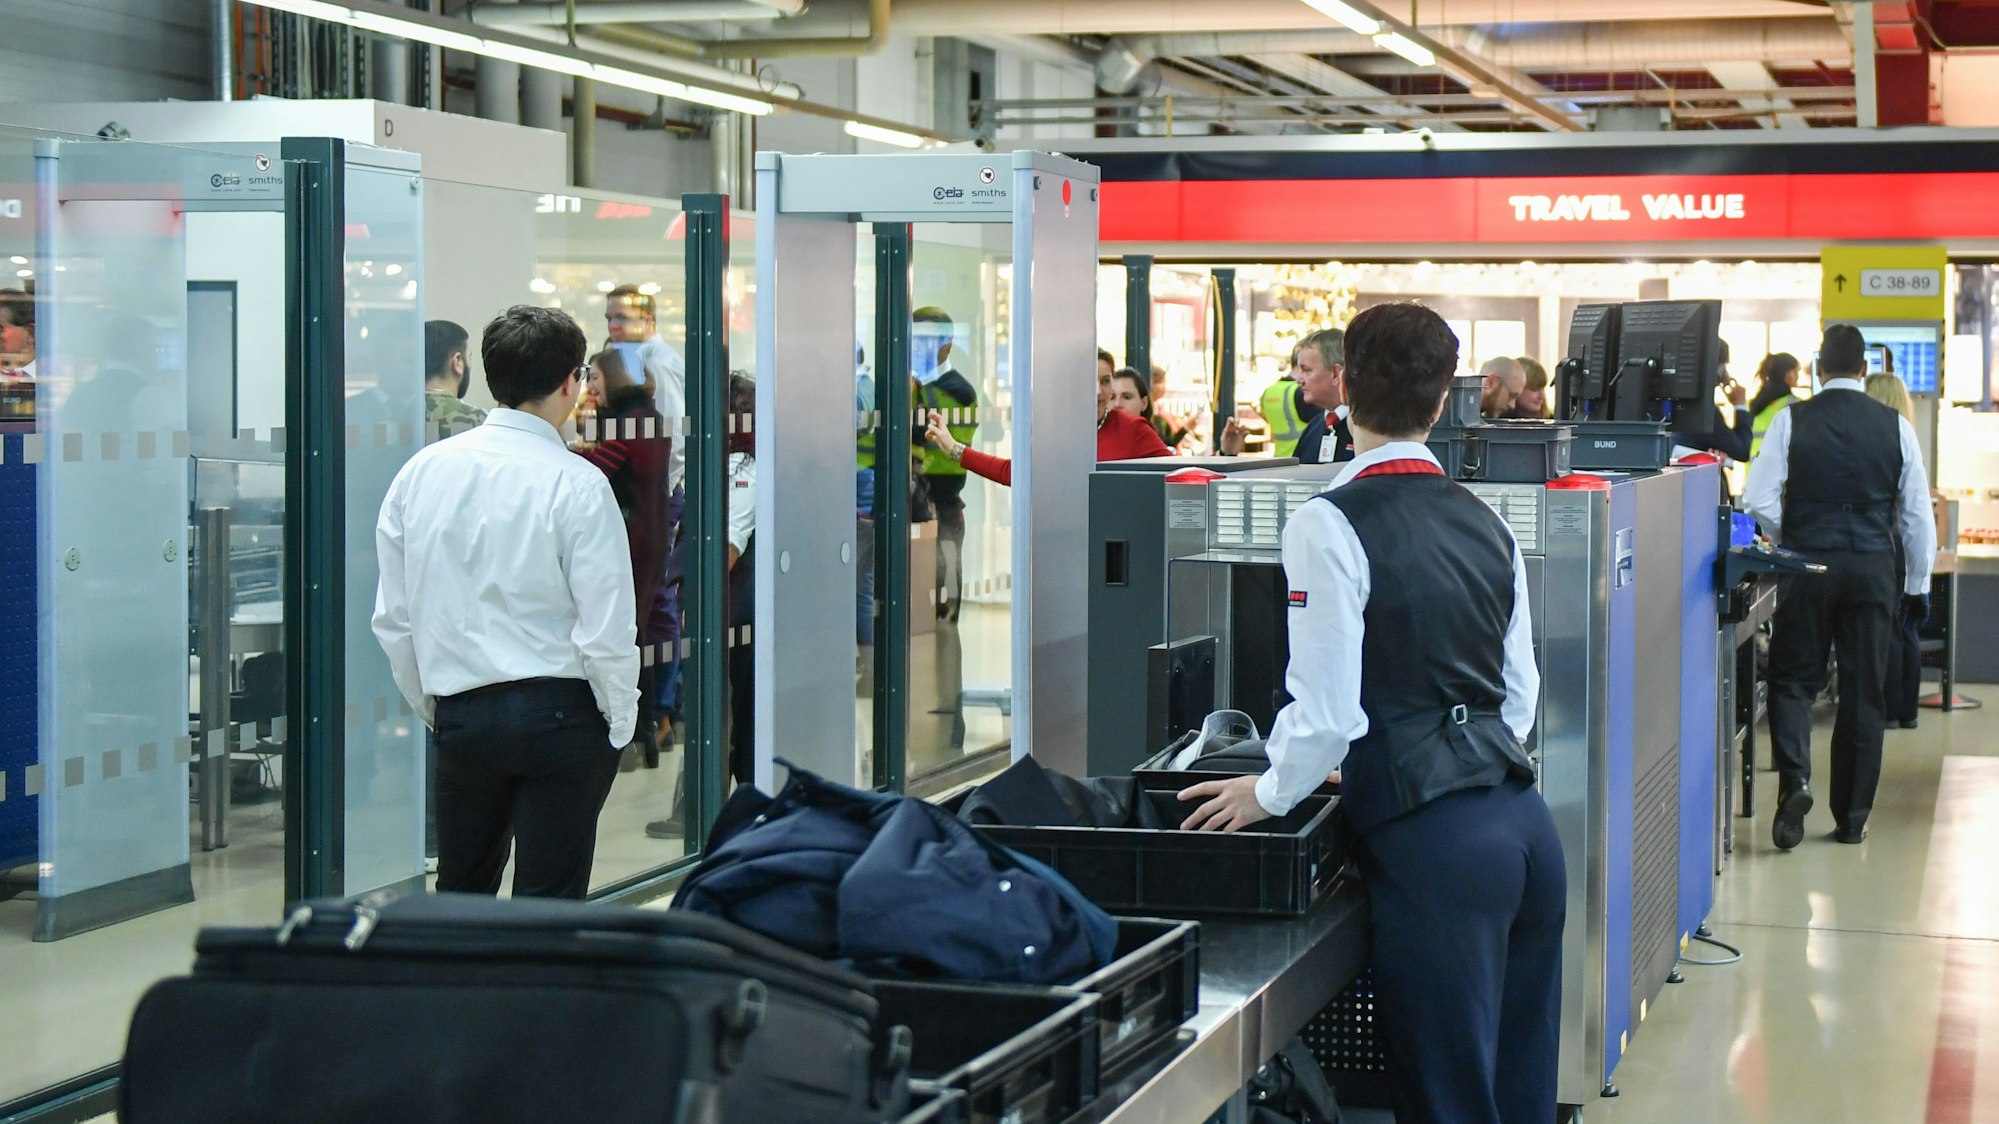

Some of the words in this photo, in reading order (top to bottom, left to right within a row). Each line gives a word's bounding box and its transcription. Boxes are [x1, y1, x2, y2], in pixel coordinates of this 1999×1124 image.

[385, 119, 394, 137] D
[248, 176, 283, 184] smiths
[971, 189, 1007, 197] smiths
[1509, 195, 1630, 221] TRAVEL
[1641, 194, 1744, 220] VALUE
[1870, 275, 1881, 289] C
[1887, 275, 1931, 290] 38-89
[1594, 440, 1617, 449] BUND
